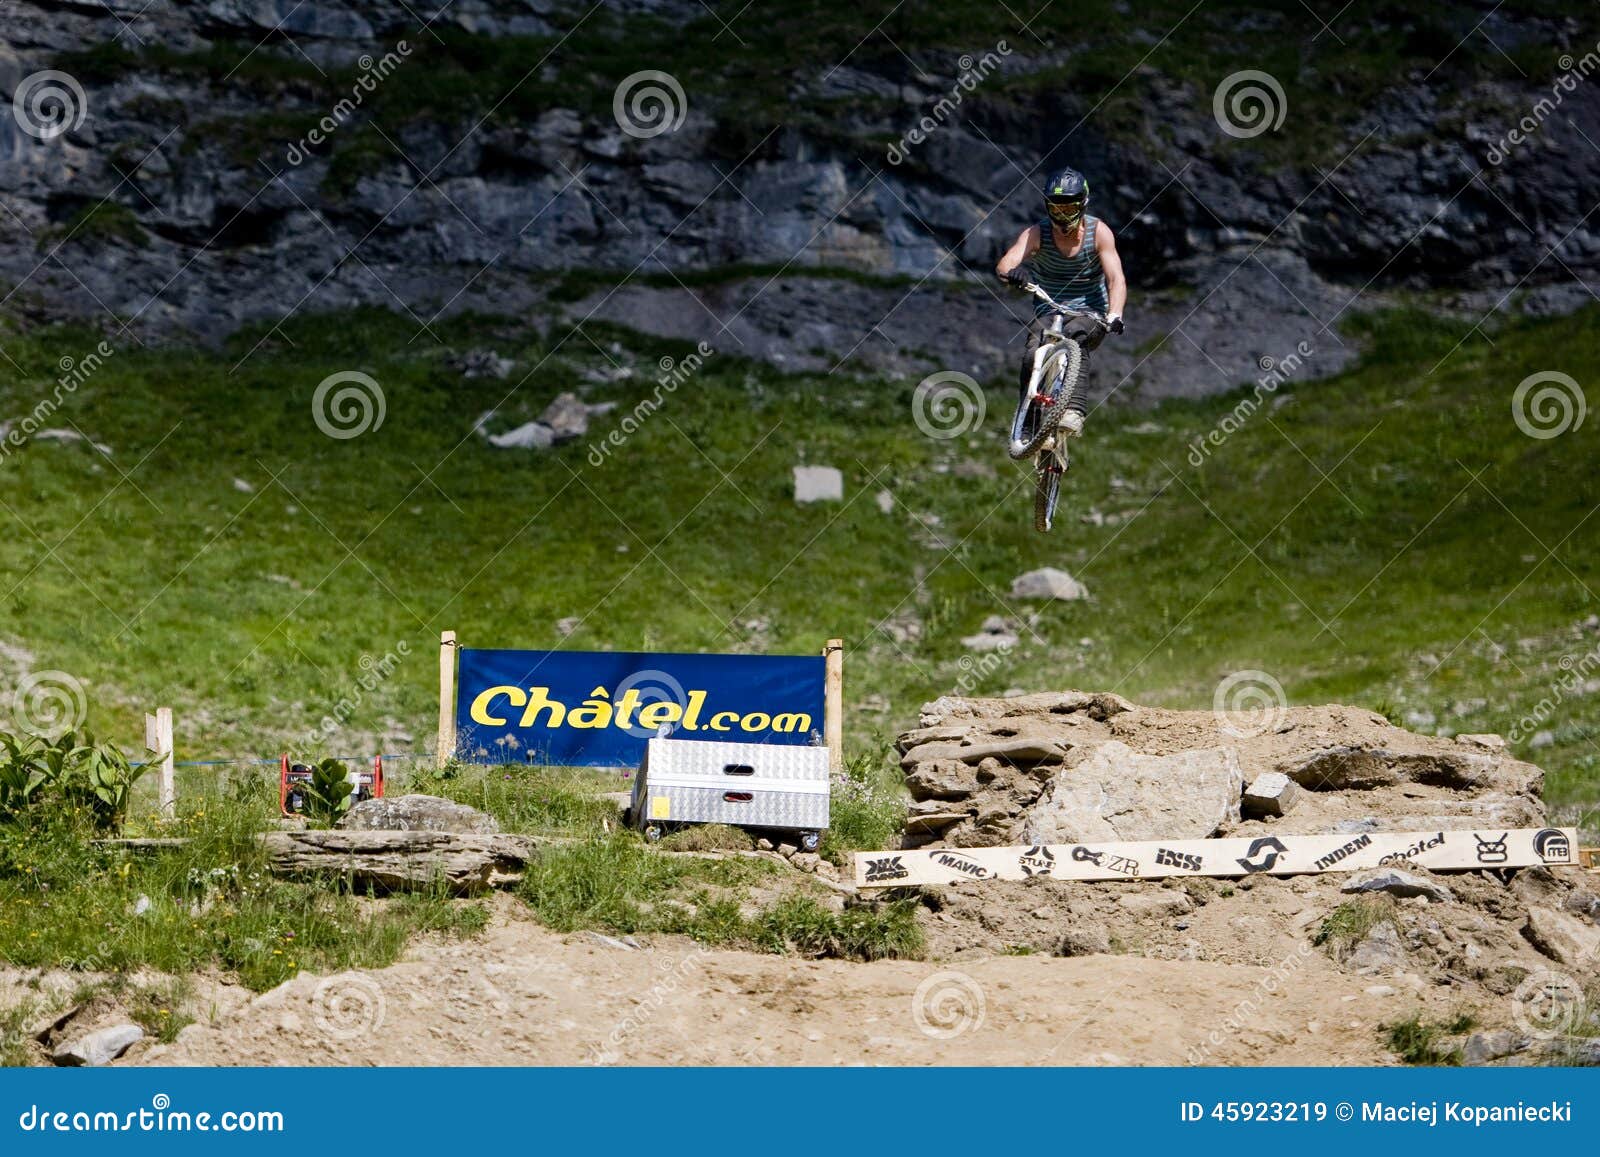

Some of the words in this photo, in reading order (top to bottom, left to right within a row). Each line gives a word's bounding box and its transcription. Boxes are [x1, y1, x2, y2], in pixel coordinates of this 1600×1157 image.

[470, 686, 812, 733] Châtel.com
[938, 854, 987, 877] MAVIC
[1314, 834, 1373, 870] INDEM
